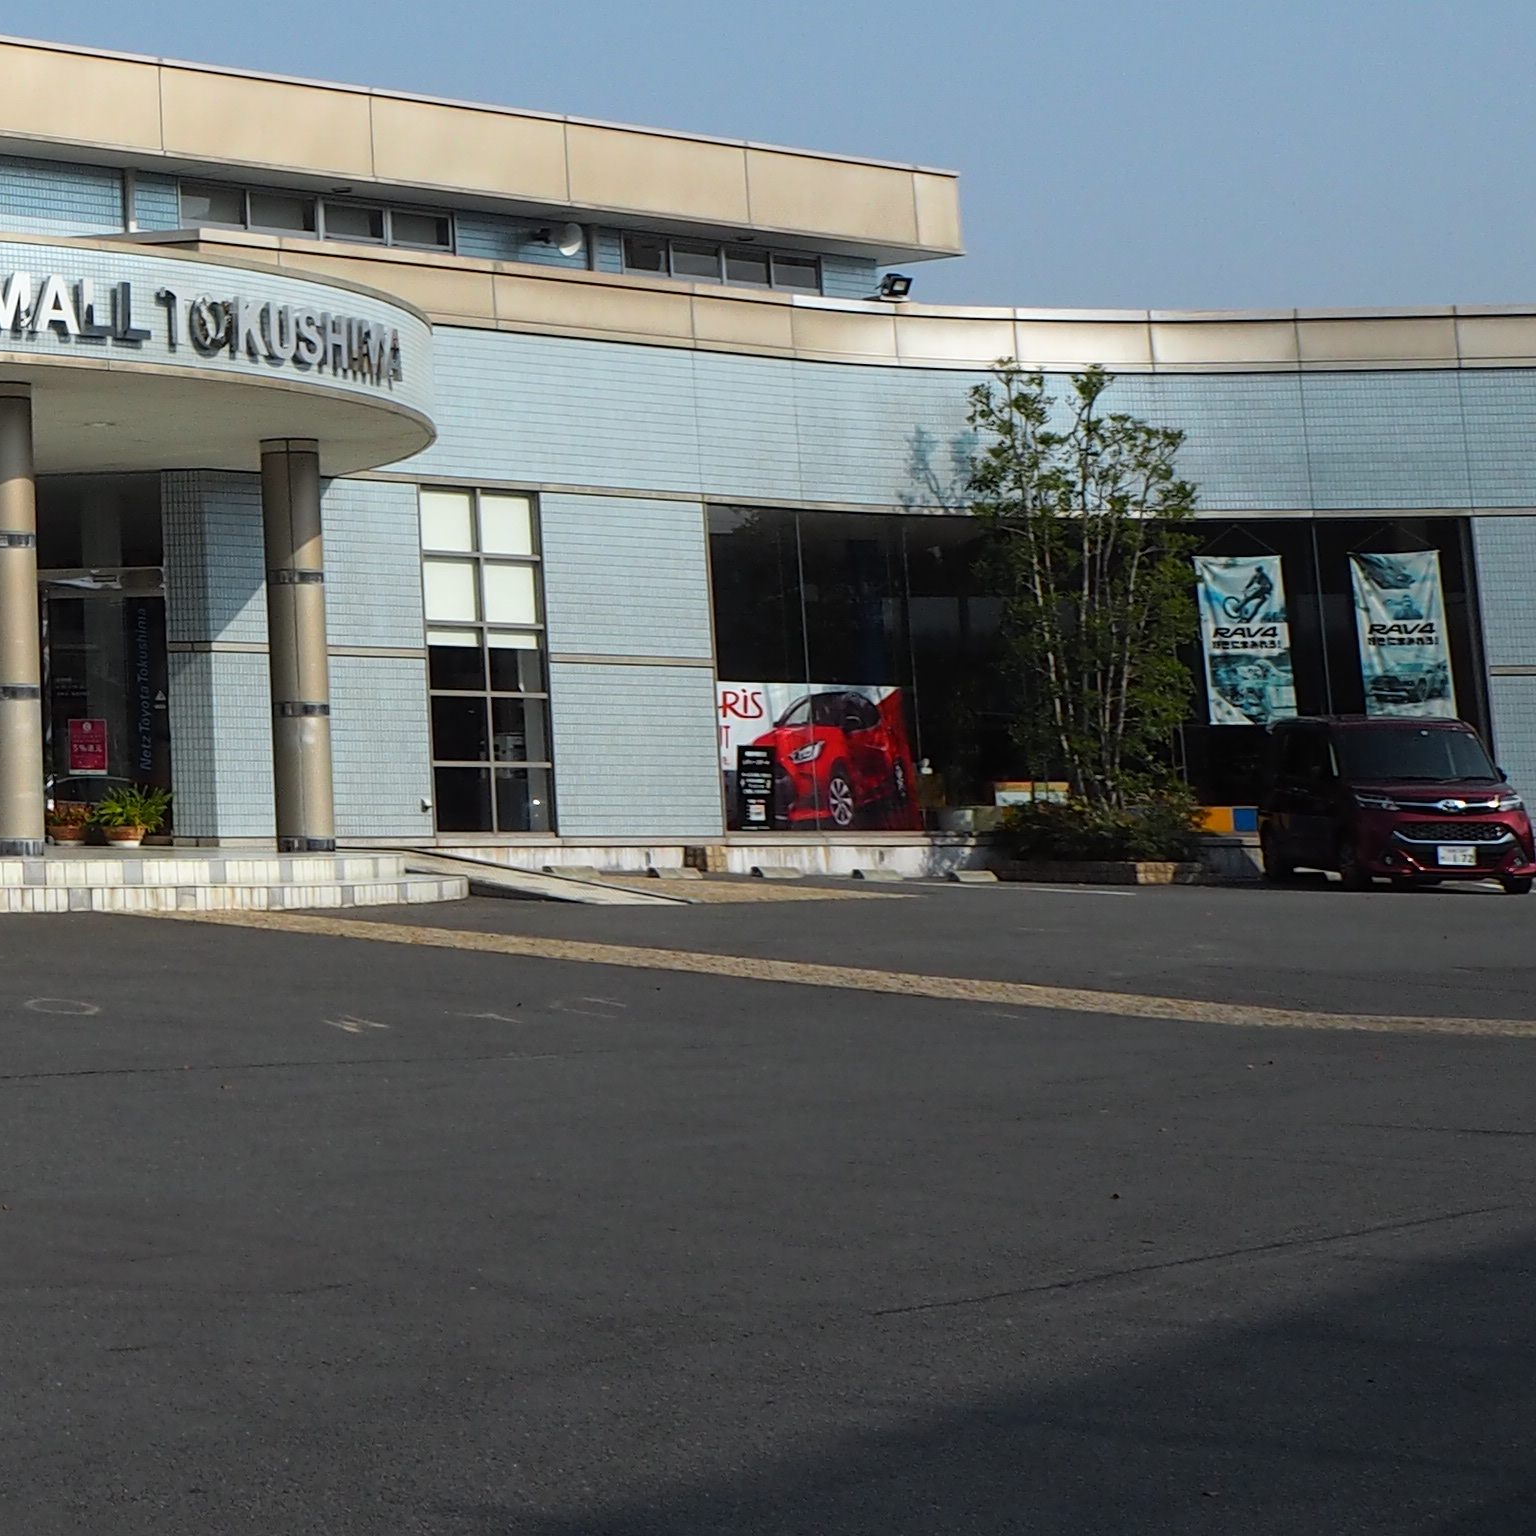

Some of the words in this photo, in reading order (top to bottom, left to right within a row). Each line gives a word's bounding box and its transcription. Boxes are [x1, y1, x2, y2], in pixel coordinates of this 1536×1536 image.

[157, 286, 403, 383] TOKUSHIMA
[136, 608, 150, 683] Tokushima
[1212, 626, 1279, 639] RAV4
[1368, 622, 1436, 635] RAV4
[138, 685, 152, 733] Toyota
